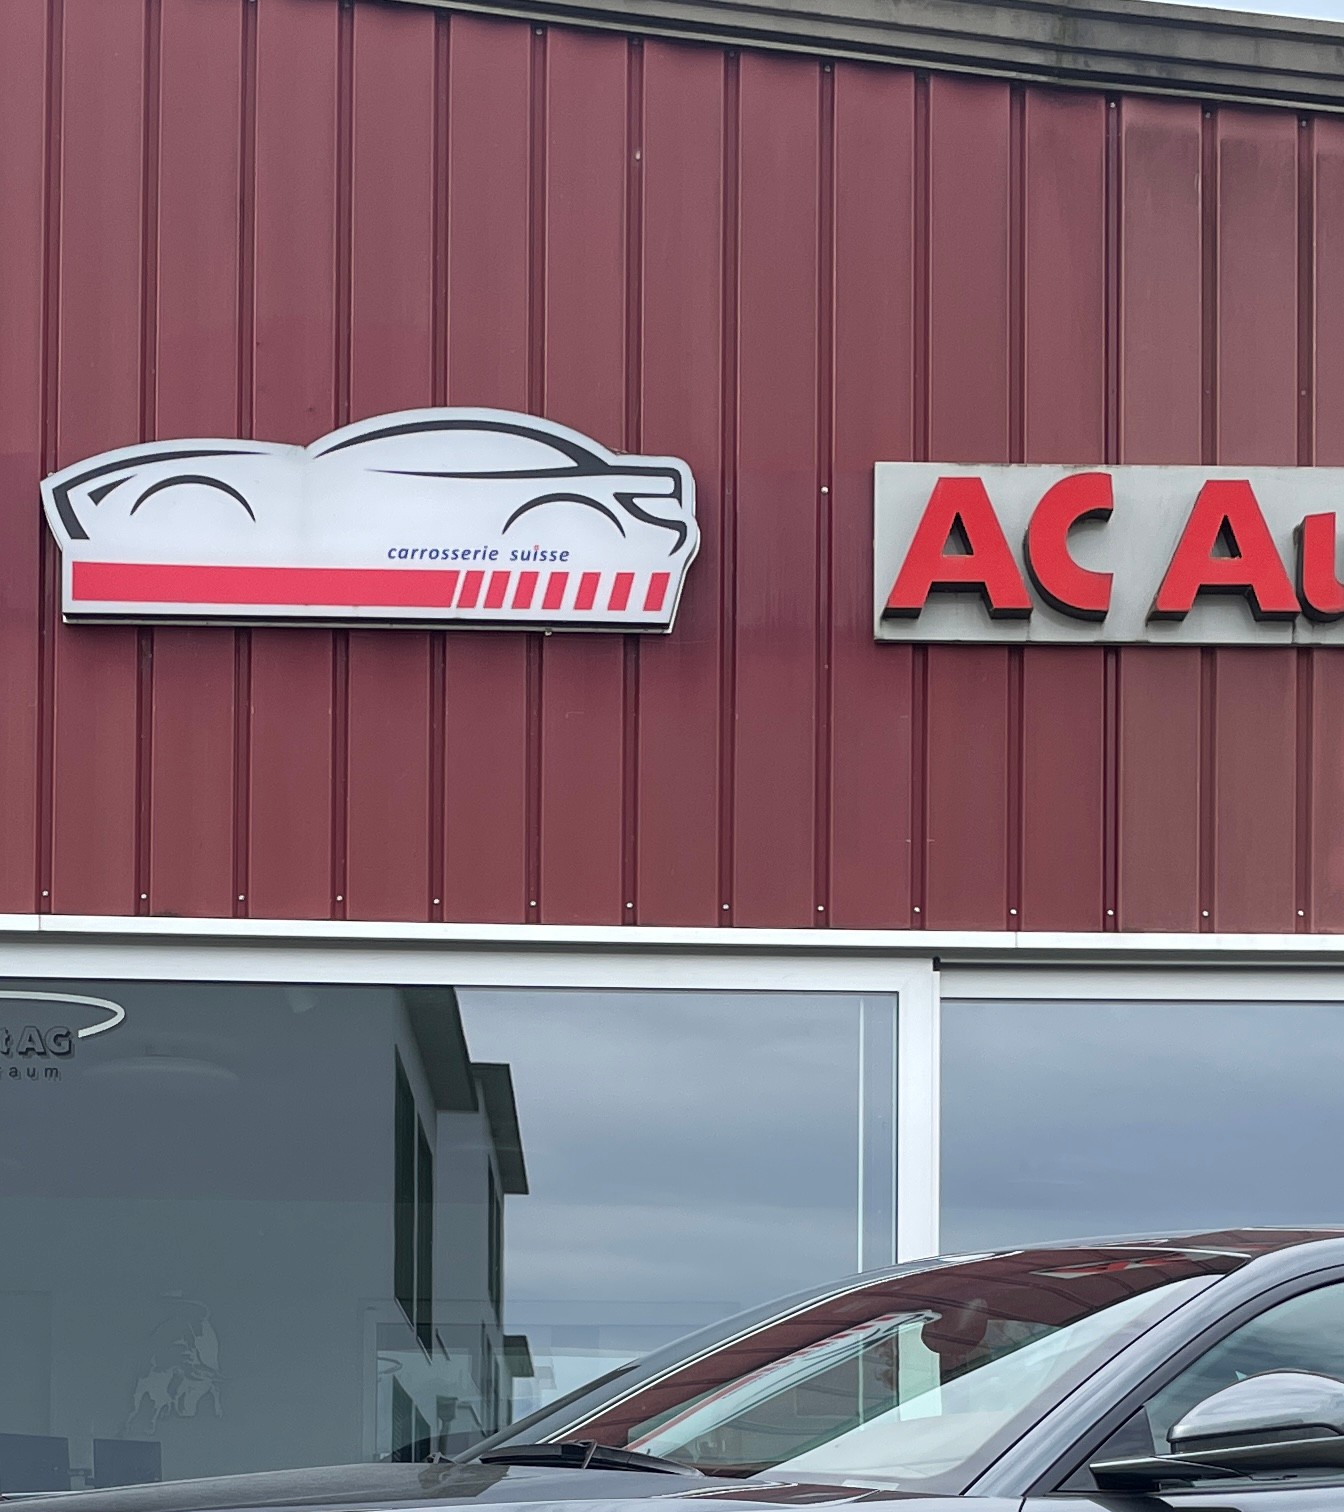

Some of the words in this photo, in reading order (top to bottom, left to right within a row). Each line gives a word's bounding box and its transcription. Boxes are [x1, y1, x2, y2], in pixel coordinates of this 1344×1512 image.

[387, 546, 499, 561] carrosserie
[509, 545, 570, 562] suisse
[882, 472, 1114, 622] AC
